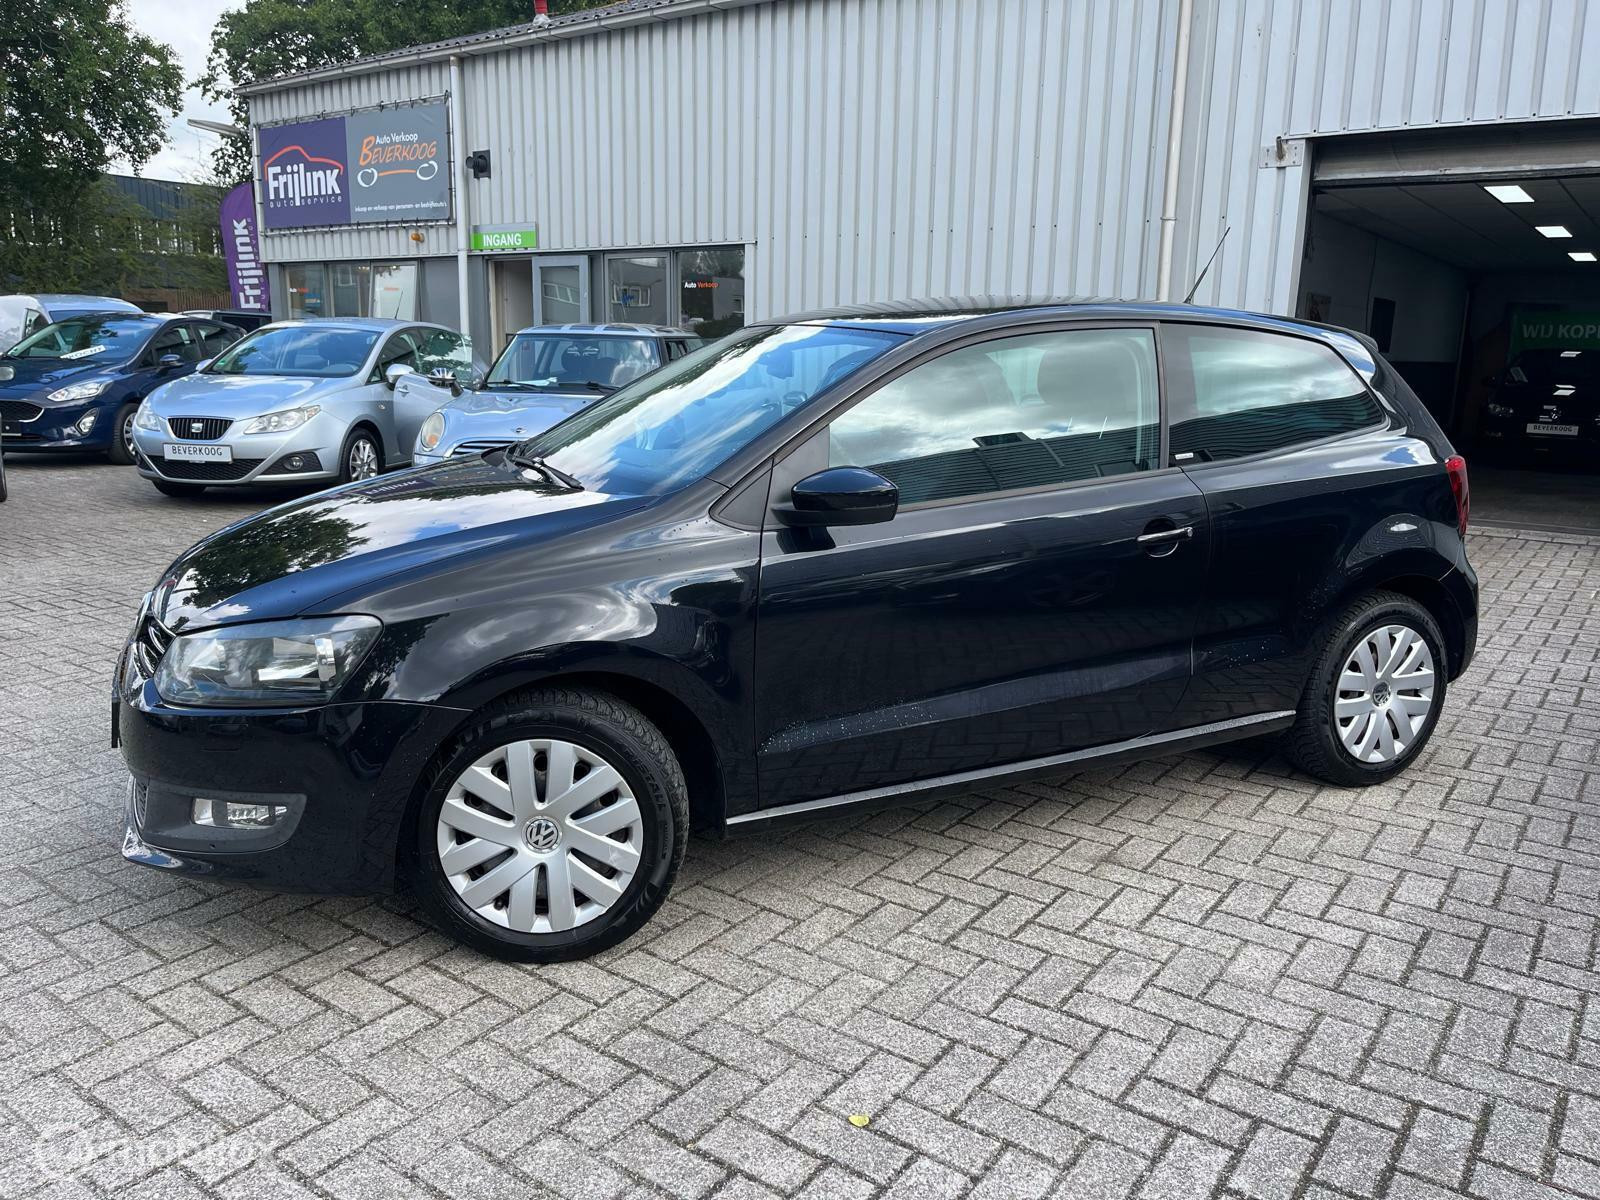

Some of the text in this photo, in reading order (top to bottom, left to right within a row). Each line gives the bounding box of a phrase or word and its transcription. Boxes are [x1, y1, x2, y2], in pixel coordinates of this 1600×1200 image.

[376, 131, 419, 144] Auto Verkoop
[359, 135, 437, 166] BEVERKOOG
[269, 196, 342, 209] auto service
[483, 233, 522, 247] INGANG
[684, 281, 719, 289] Auto Verkoop
[1523, 323, 1600, 339] WIJ KOP
[171, 445, 223, 456] BEVERKOOG
